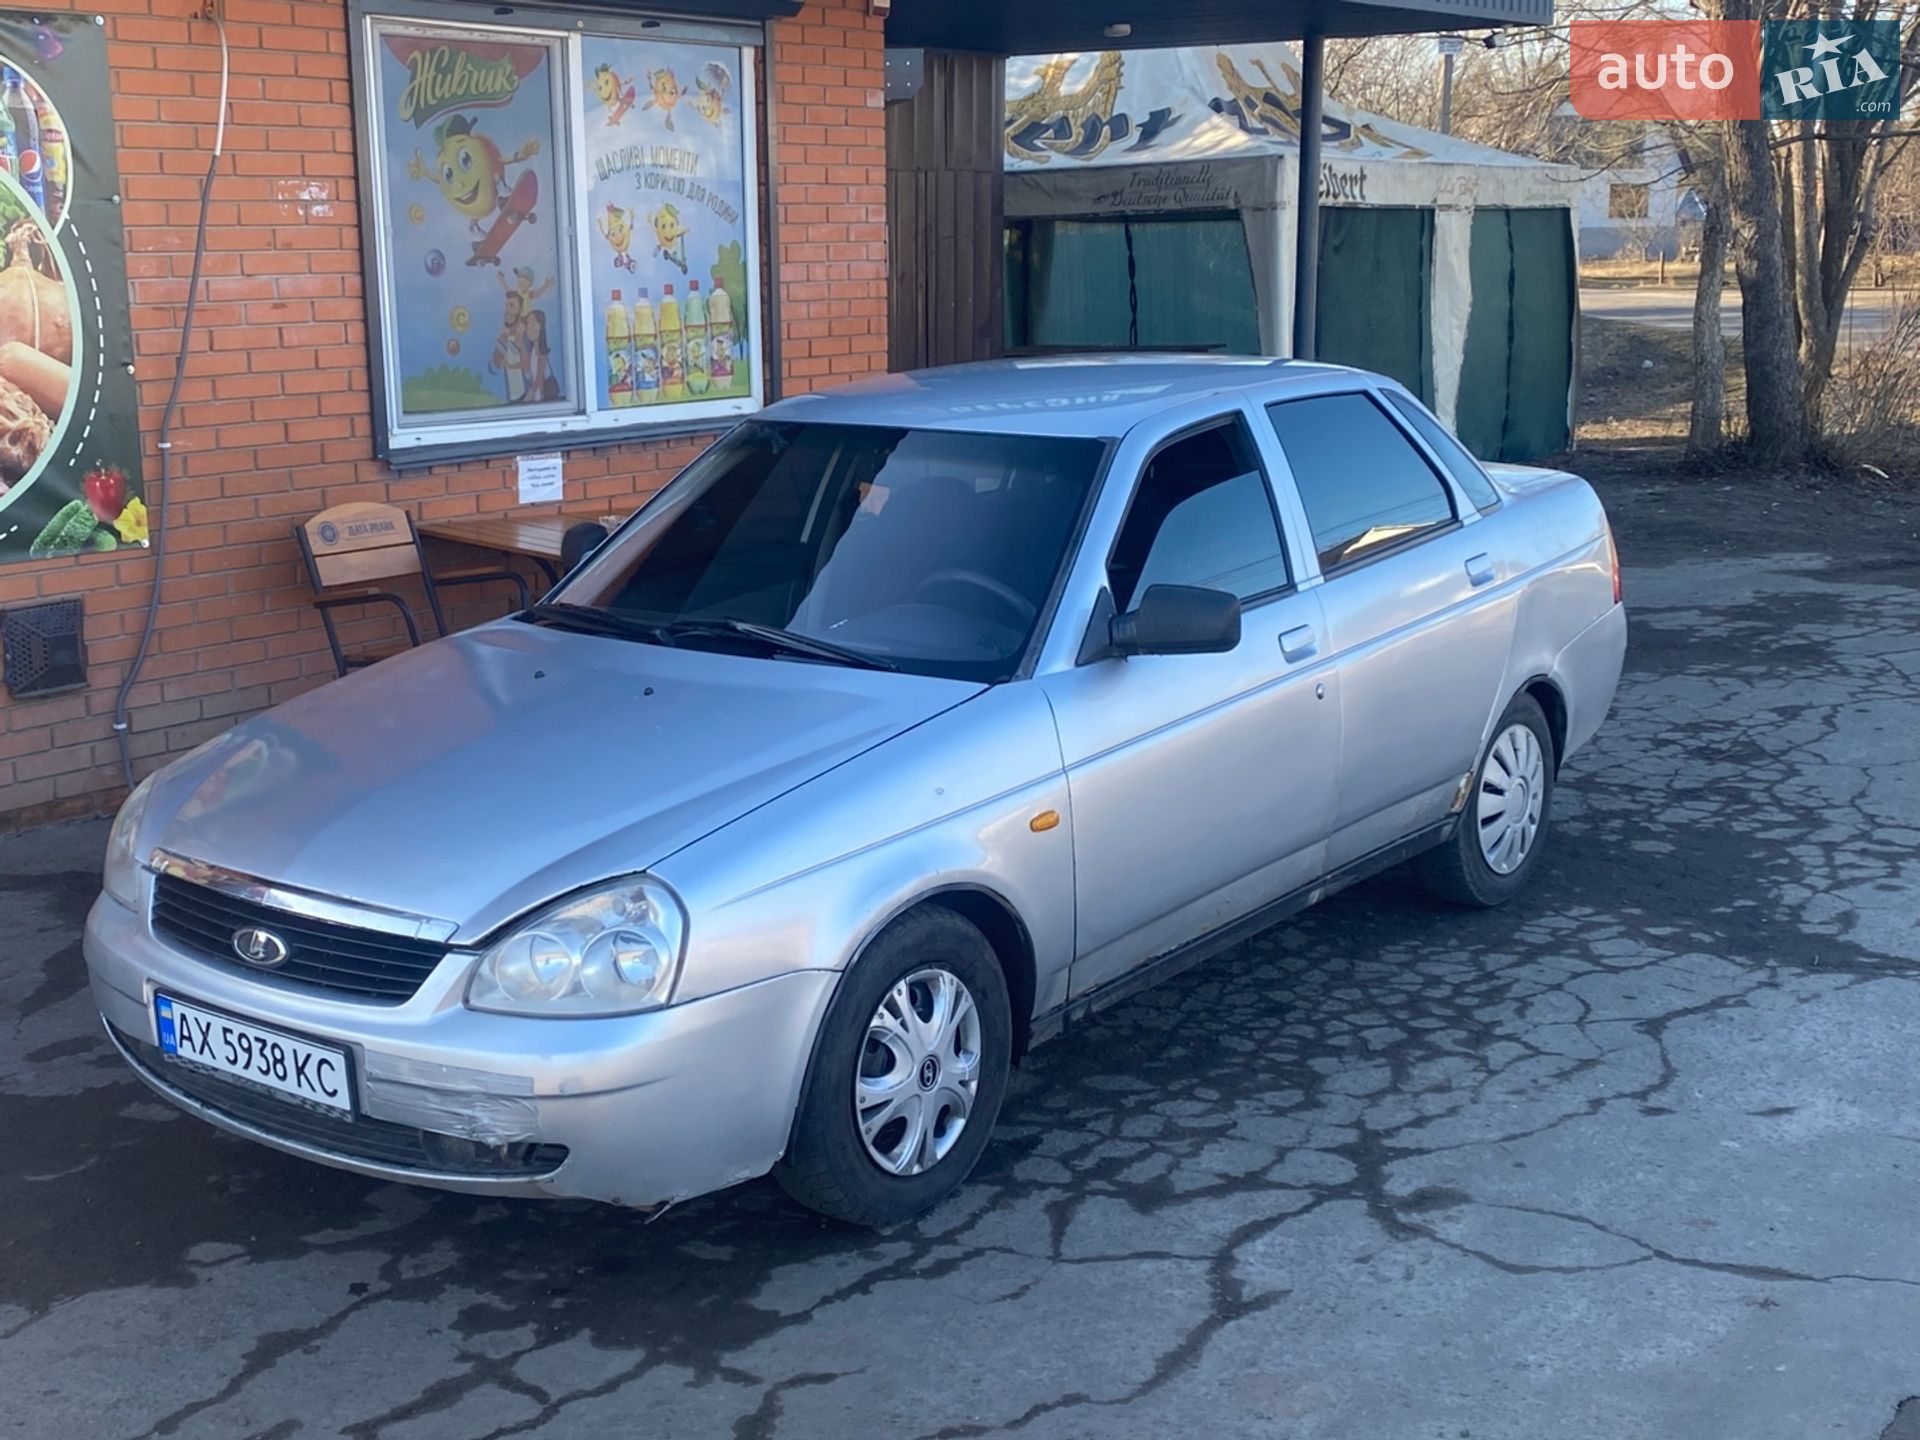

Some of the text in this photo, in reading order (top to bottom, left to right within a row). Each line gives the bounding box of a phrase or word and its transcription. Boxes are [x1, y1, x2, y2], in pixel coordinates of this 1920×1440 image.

[595, 145, 699, 181] ЩАСЛИВІ МОМЕНТИ
[686, 182, 706, 202] ДЛЯ
[706, 191, 740, 227] РОДИНИ
[163, 1032, 176, 1047] UA
[179, 1012, 338, 1098] AX 5938 KC
